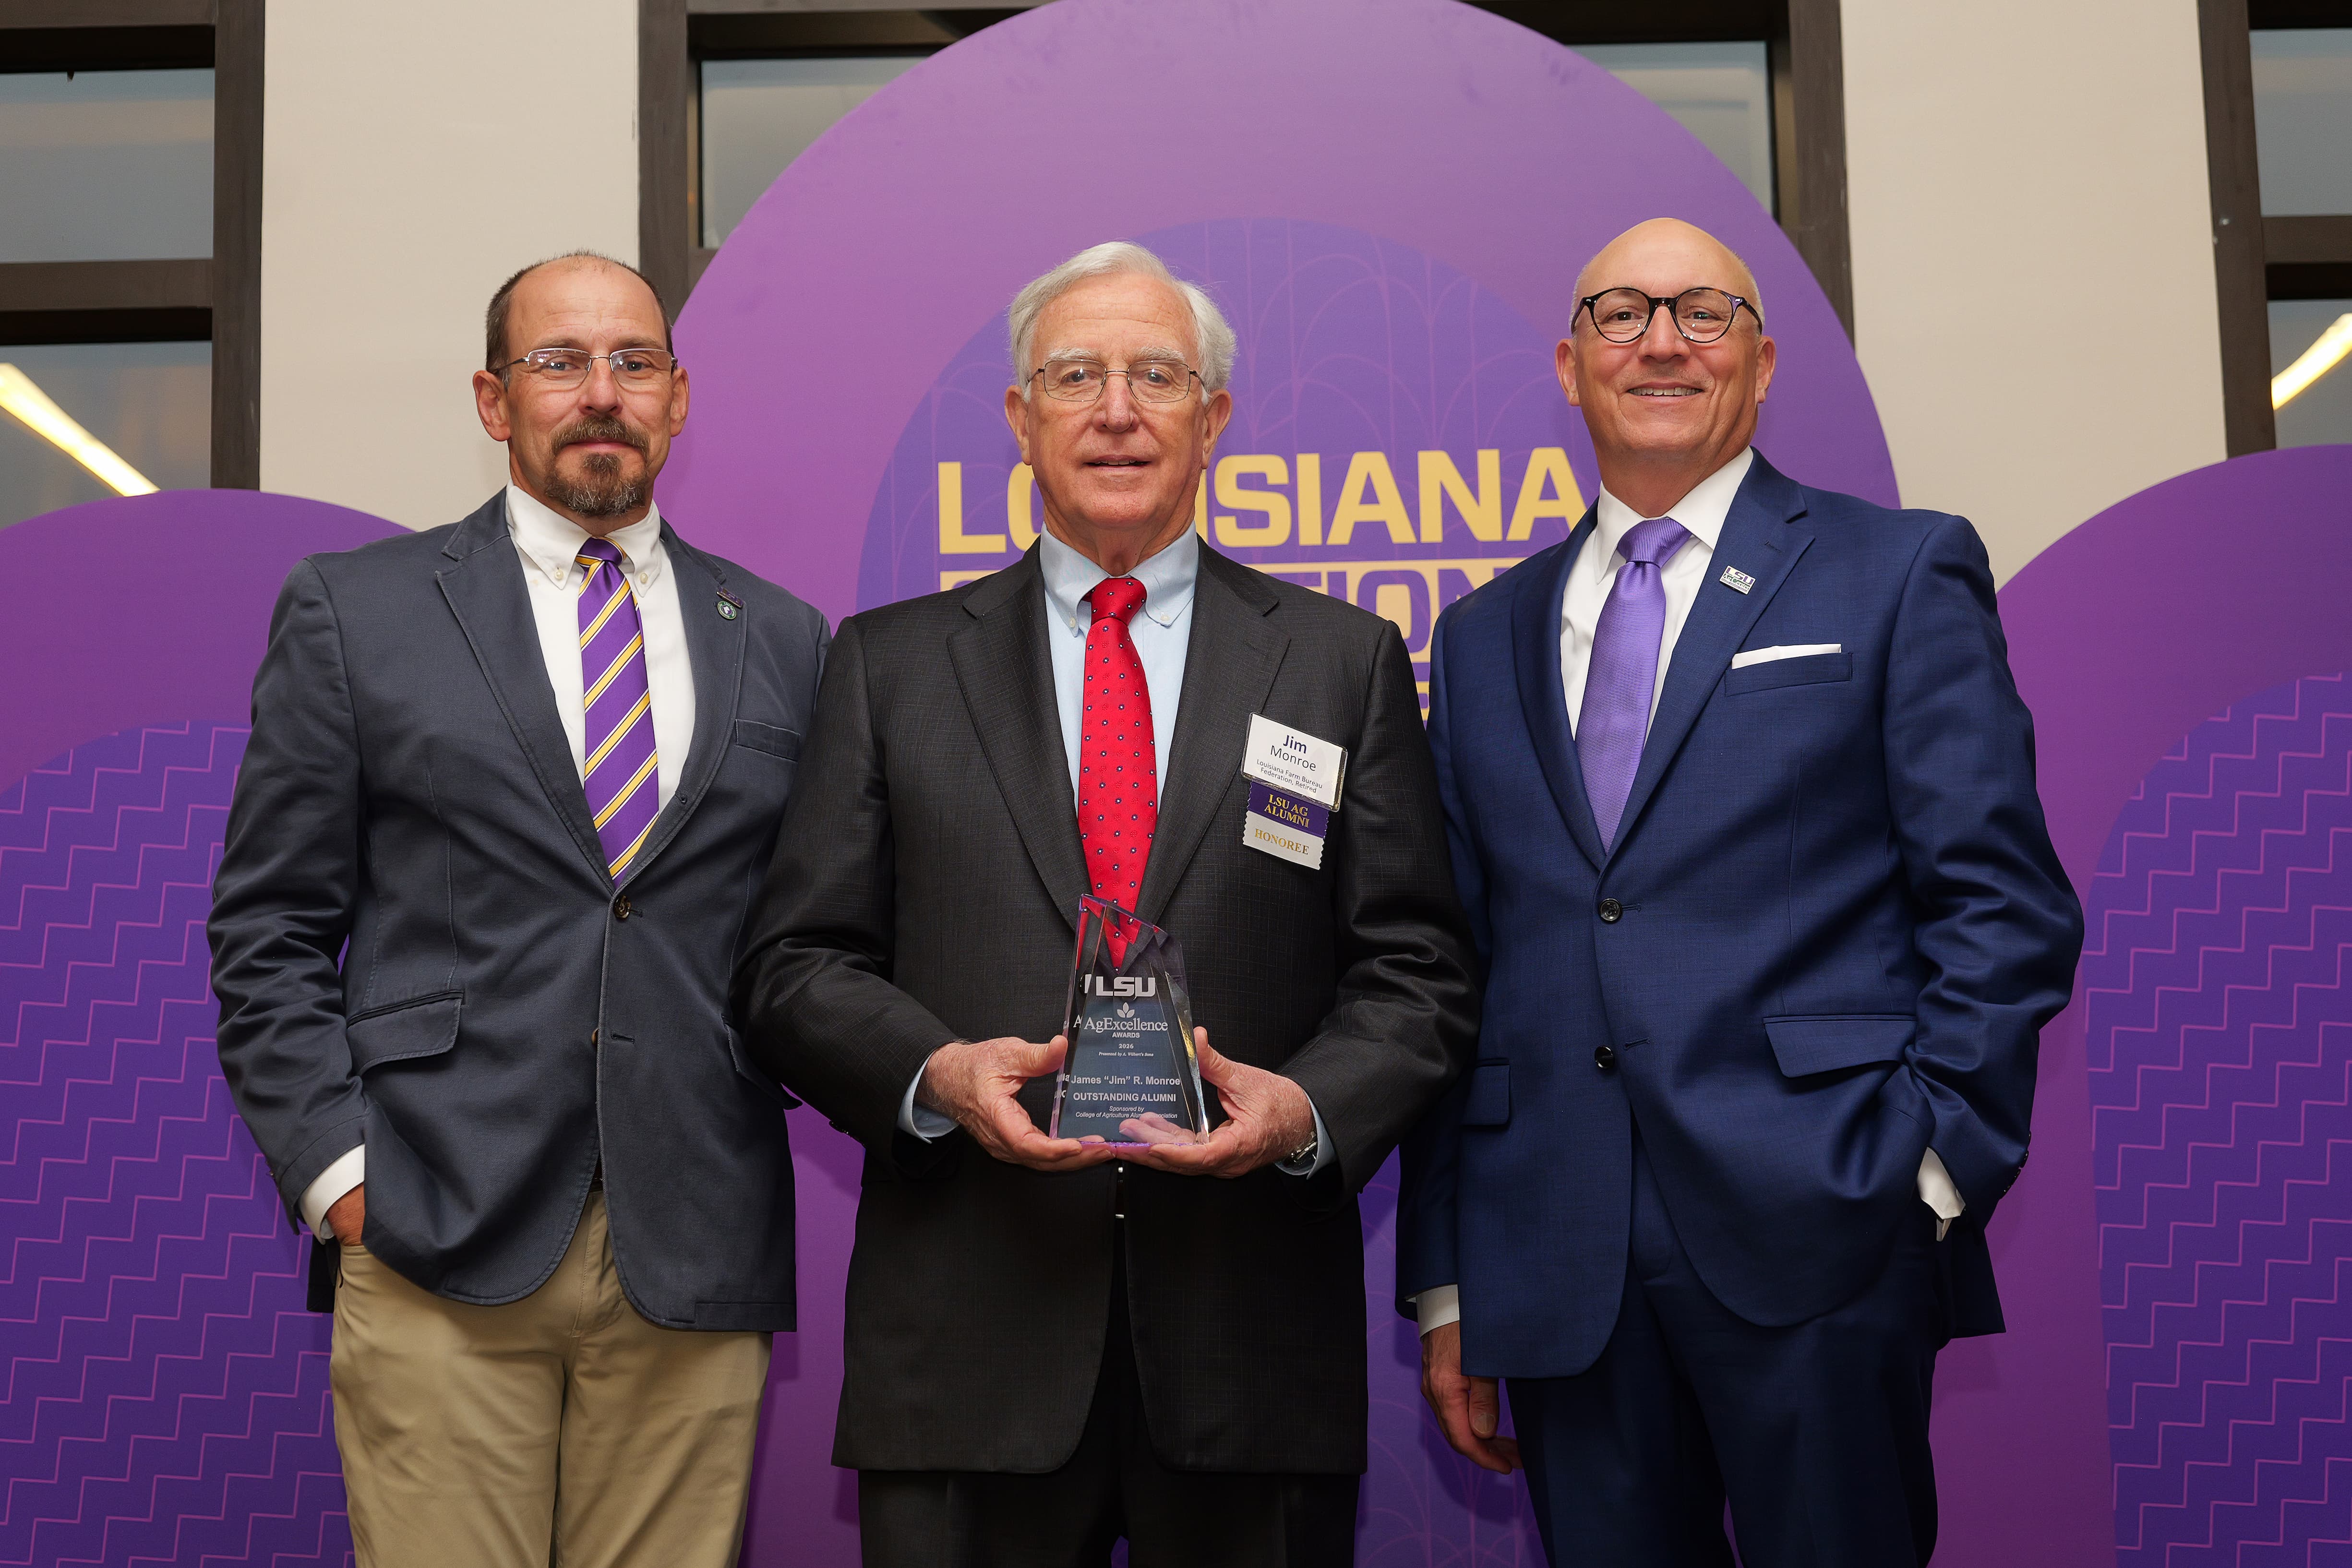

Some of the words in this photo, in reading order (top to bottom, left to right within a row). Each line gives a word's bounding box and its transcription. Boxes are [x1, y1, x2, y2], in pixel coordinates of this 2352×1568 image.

[938, 447, 1587, 554] LSIANA
[1726, 567, 1754, 585] LSU
[1283, 735, 1307, 754] Jim
[1271, 745, 1316, 771] Monroe
[1257, 759, 1284, 774] Louisiana
[1285, 770, 1300, 780] Farm
[1302, 776, 1323, 789] Bureau
[1260, 767, 1294, 785] Federation,
[1296, 780, 1317, 793] Retired
[1264, 804, 1310, 828] ALUMNI
[1269, 794, 1290, 809] LSU
[1291, 804, 1308, 816] AG
[1254, 828, 1309, 855] HONOREE
[1096, 976, 1156, 999] LSU
[1084, 1017, 1168, 1033] AgExcellence
[1071, 1076, 1101, 1084] James
[1104, 1076, 1130, 1085] “Jim”
[1133, 1076, 1143, 1085] R.
[1145, 1076, 1180, 1085] Monroe
[1073, 1092, 1139, 1101] OUTSTANDING
[1140, 1093, 1176, 1102] ALUMNI
